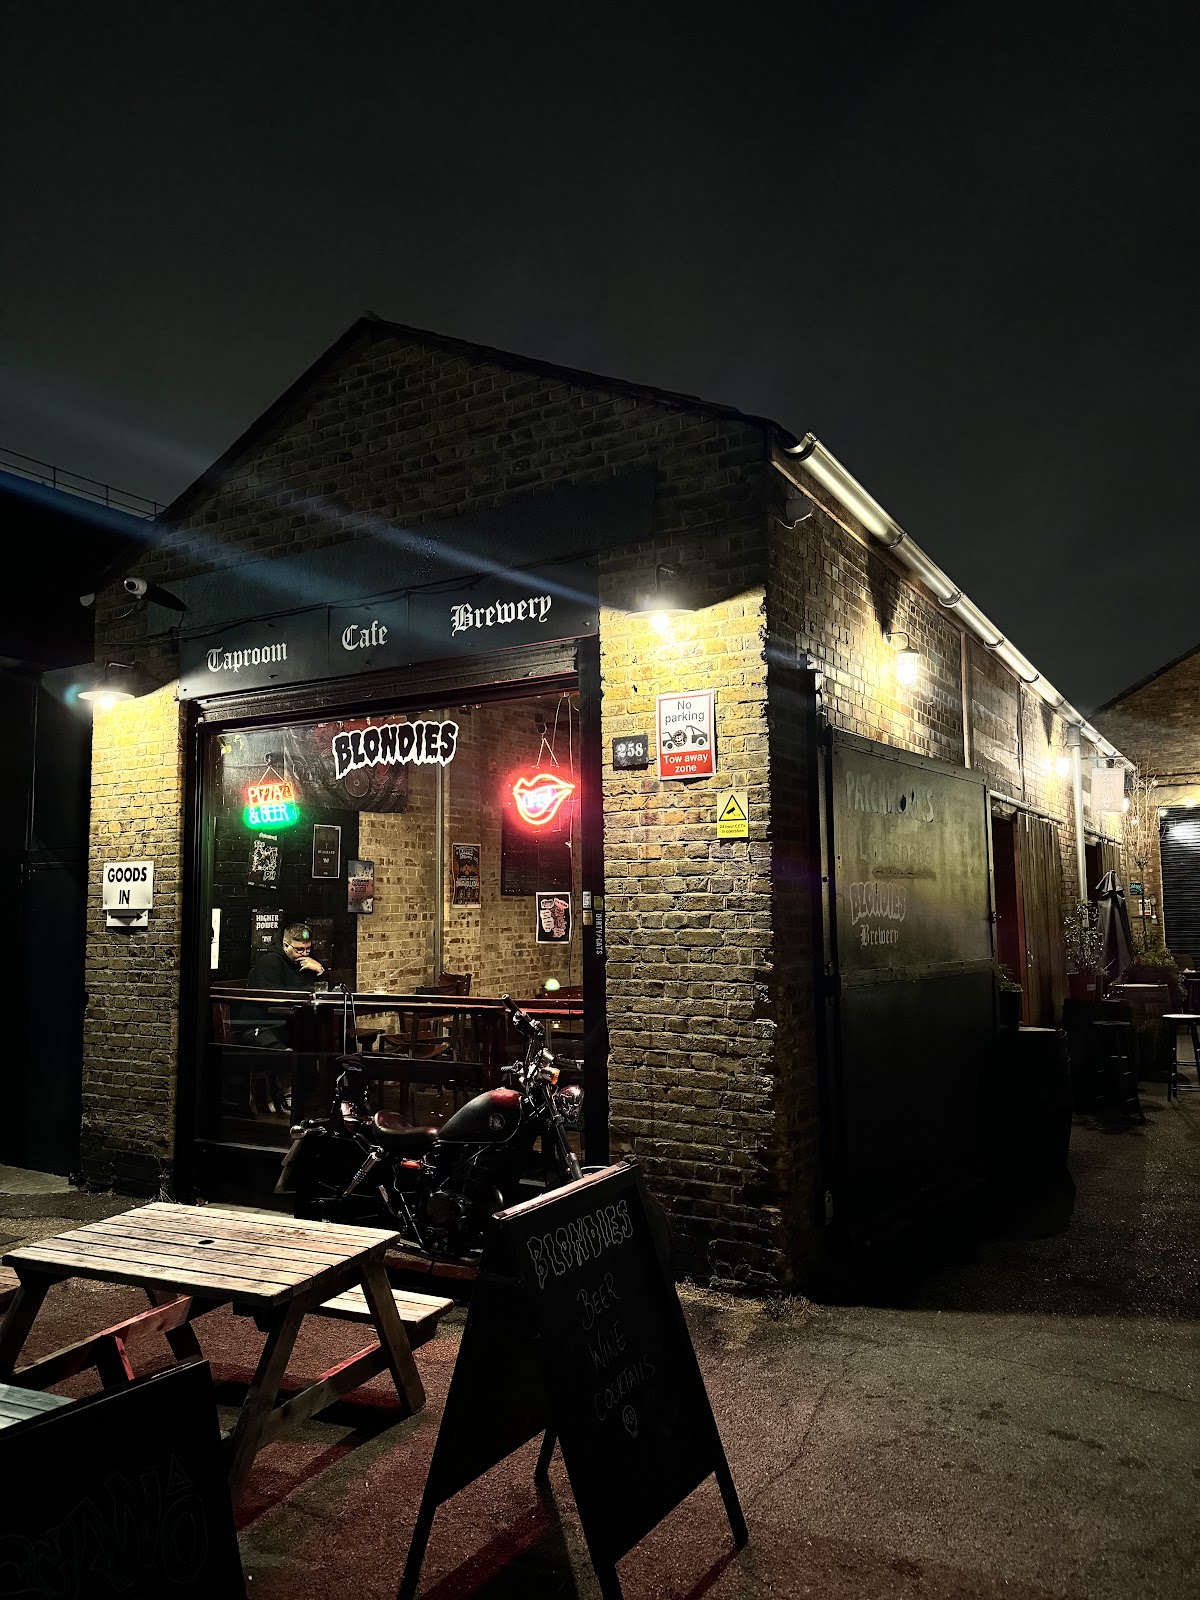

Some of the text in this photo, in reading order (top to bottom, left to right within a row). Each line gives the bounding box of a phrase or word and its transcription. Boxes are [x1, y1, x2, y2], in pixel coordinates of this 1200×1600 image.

[450, 595, 552, 637] Brewery
[341, 620, 388, 650] Cafe
[207, 642, 288, 673] Taproom
[677, 701, 692, 710] No
[665, 711, 705, 724] parking
[332, 720, 459, 780] BLONDIES
[617, 742, 643, 757] 258
[663, 752, 708, 764] Tow away
[675, 763, 697, 773] zone
[247, 784, 286, 806] PIZZA
[260, 803, 289, 823] BEER
[108, 867, 147, 882] GOODS
[119, 890, 130, 904] IN
[595, 912, 603, 955] DIRTY CATS
[860, 923, 899, 950] Brewery
[527, 1200, 634, 1289] BLONDIES
[577, 1272, 622, 1330] BEER
